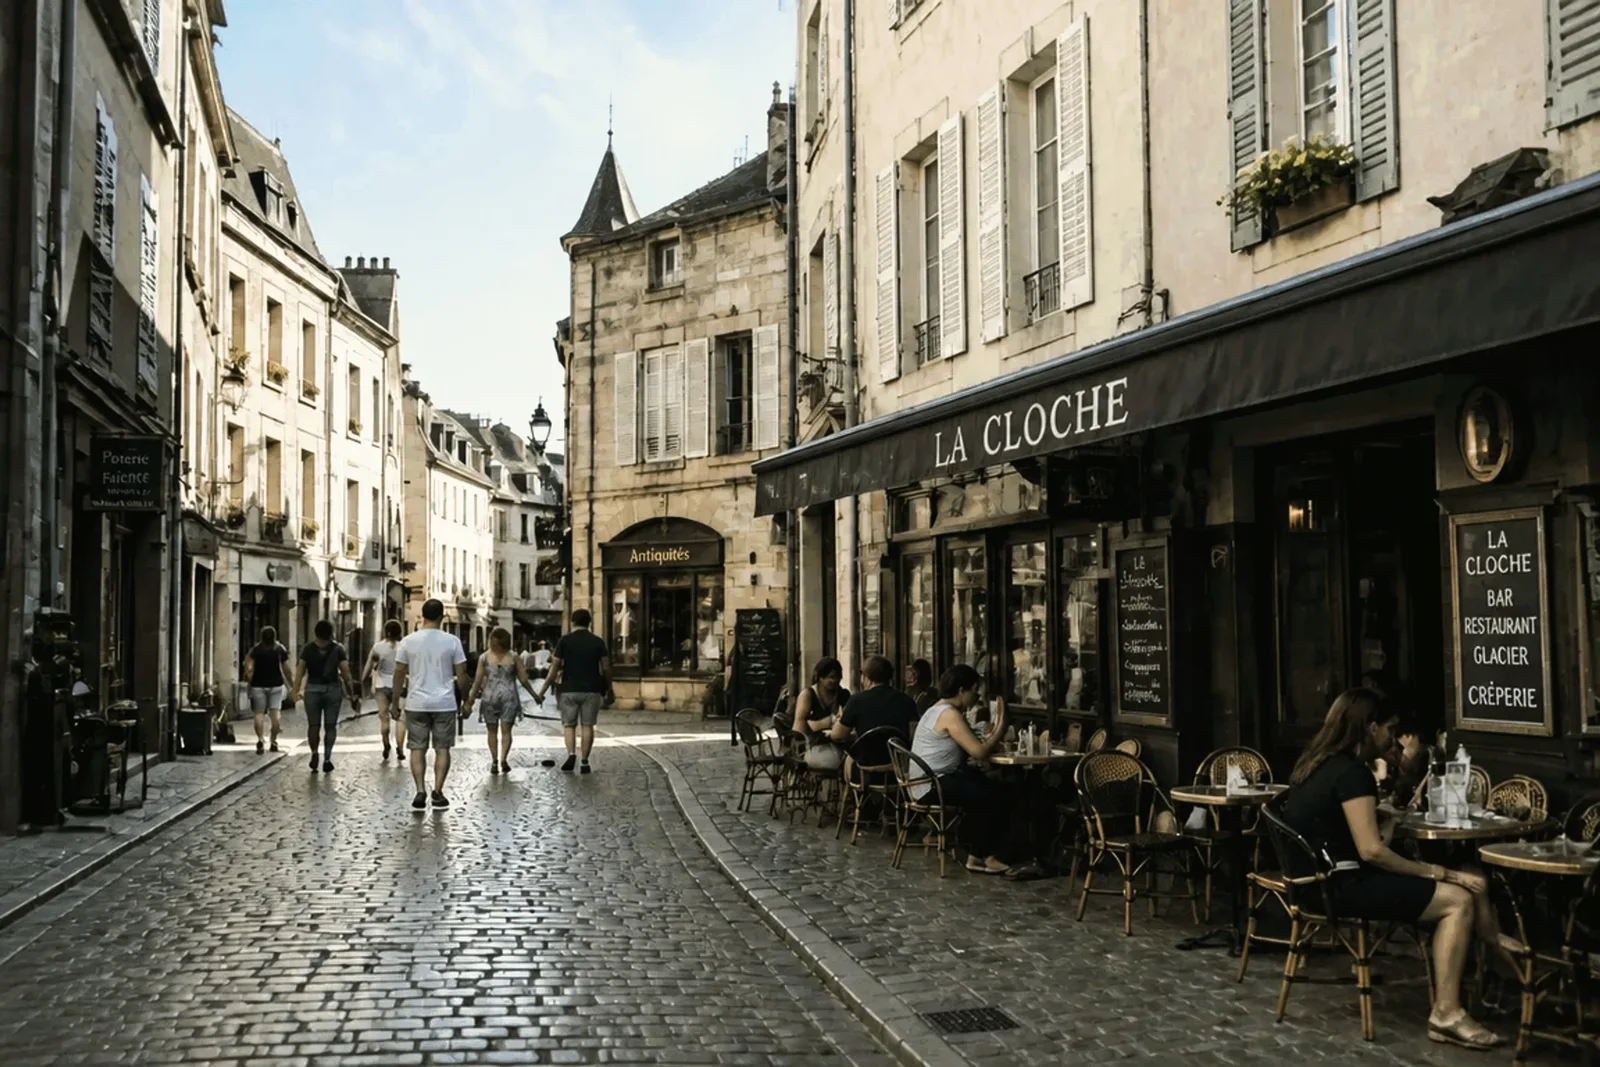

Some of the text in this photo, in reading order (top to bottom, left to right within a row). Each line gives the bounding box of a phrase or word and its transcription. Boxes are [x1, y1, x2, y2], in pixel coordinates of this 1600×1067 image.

[935, 377, 1129, 467] LA CLOCHE
[1487, 530, 1508, 549] LA
[629, 546, 690, 566] Antiquités
[1465, 553, 1532, 575] CLOCHE
[1487, 588, 1513, 607] BAR
[1464, 616, 1537, 635] RESTAURANT
[1473, 646, 1529, 665] GLACIER
